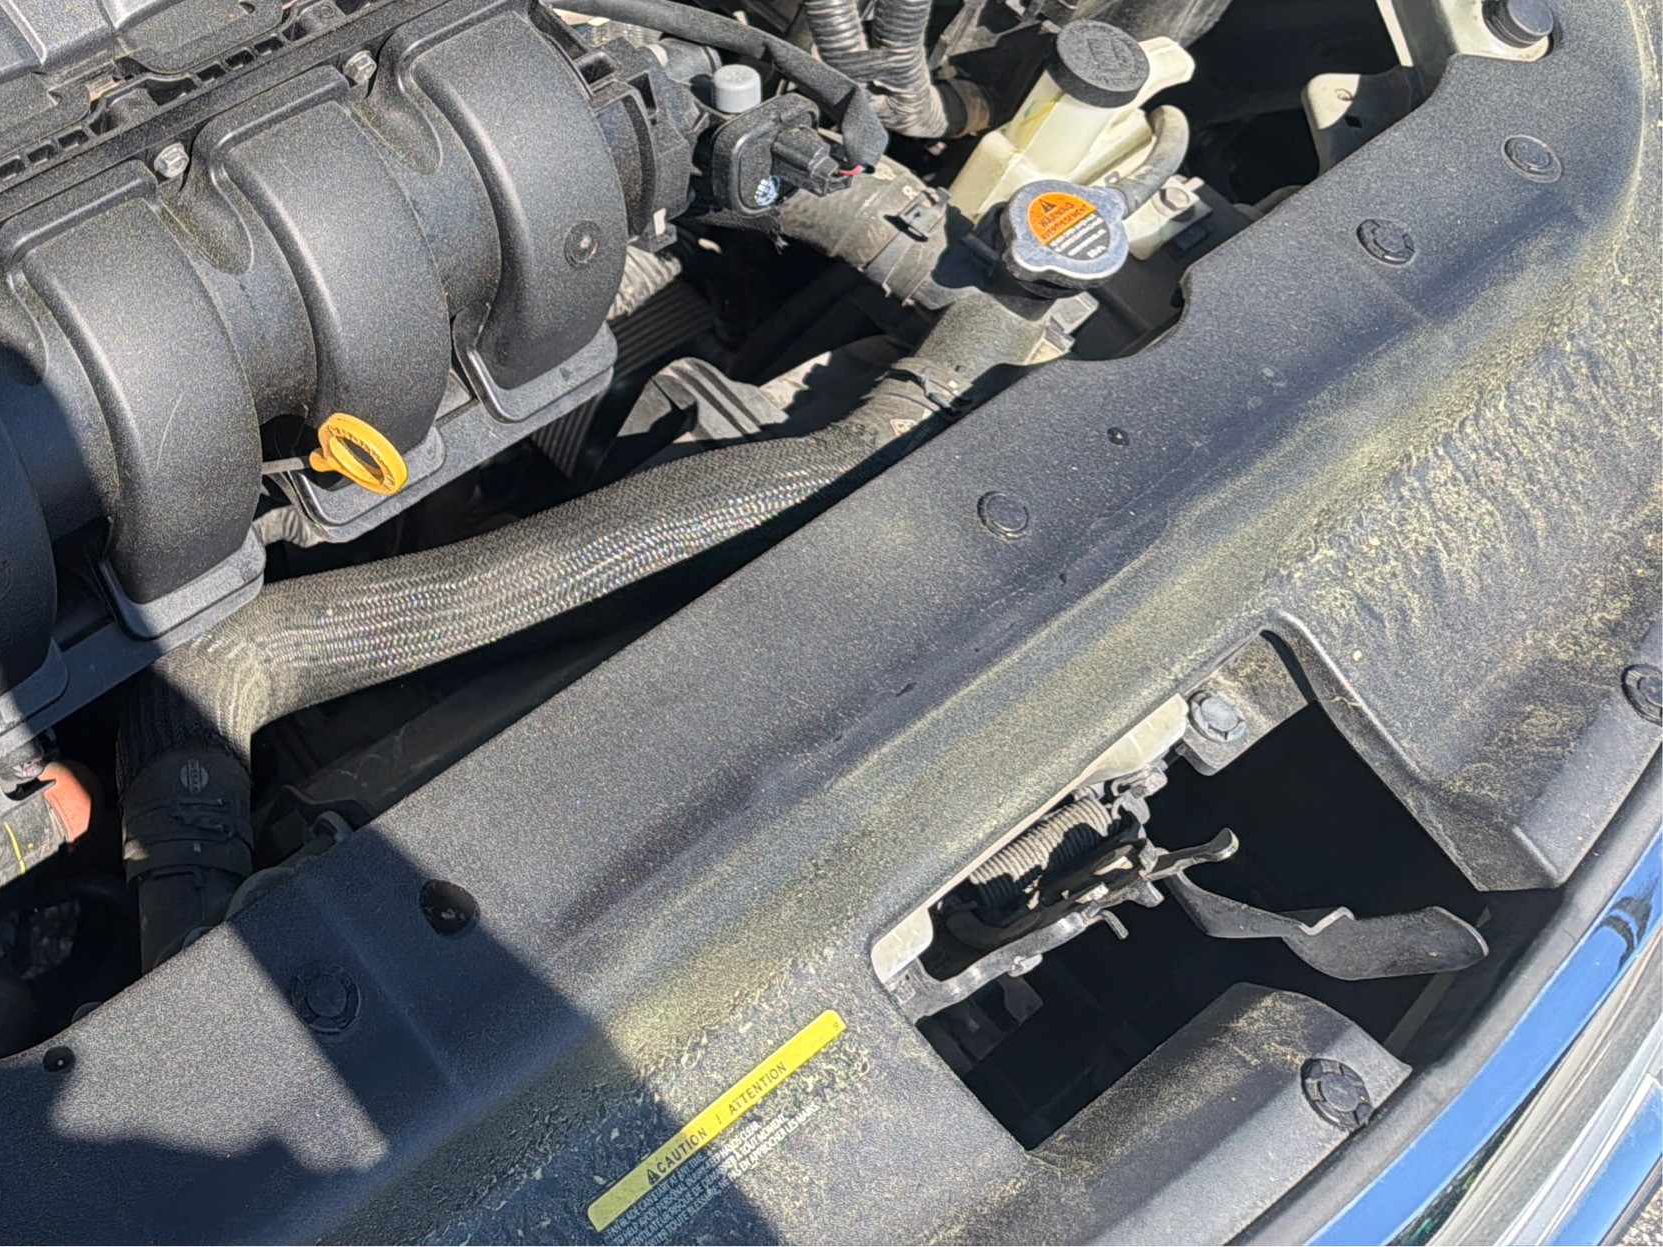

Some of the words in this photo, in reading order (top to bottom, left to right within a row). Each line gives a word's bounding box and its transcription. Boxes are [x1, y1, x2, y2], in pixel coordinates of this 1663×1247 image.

[656, 1128, 708, 1174] CAUTION
[727, 1062, 787, 1114] ATTENTION
[638, 1195, 654, 1210] CAN
[650, 1181, 670, 1199] START
[655, 1182, 687, 1211] PERSONAL
